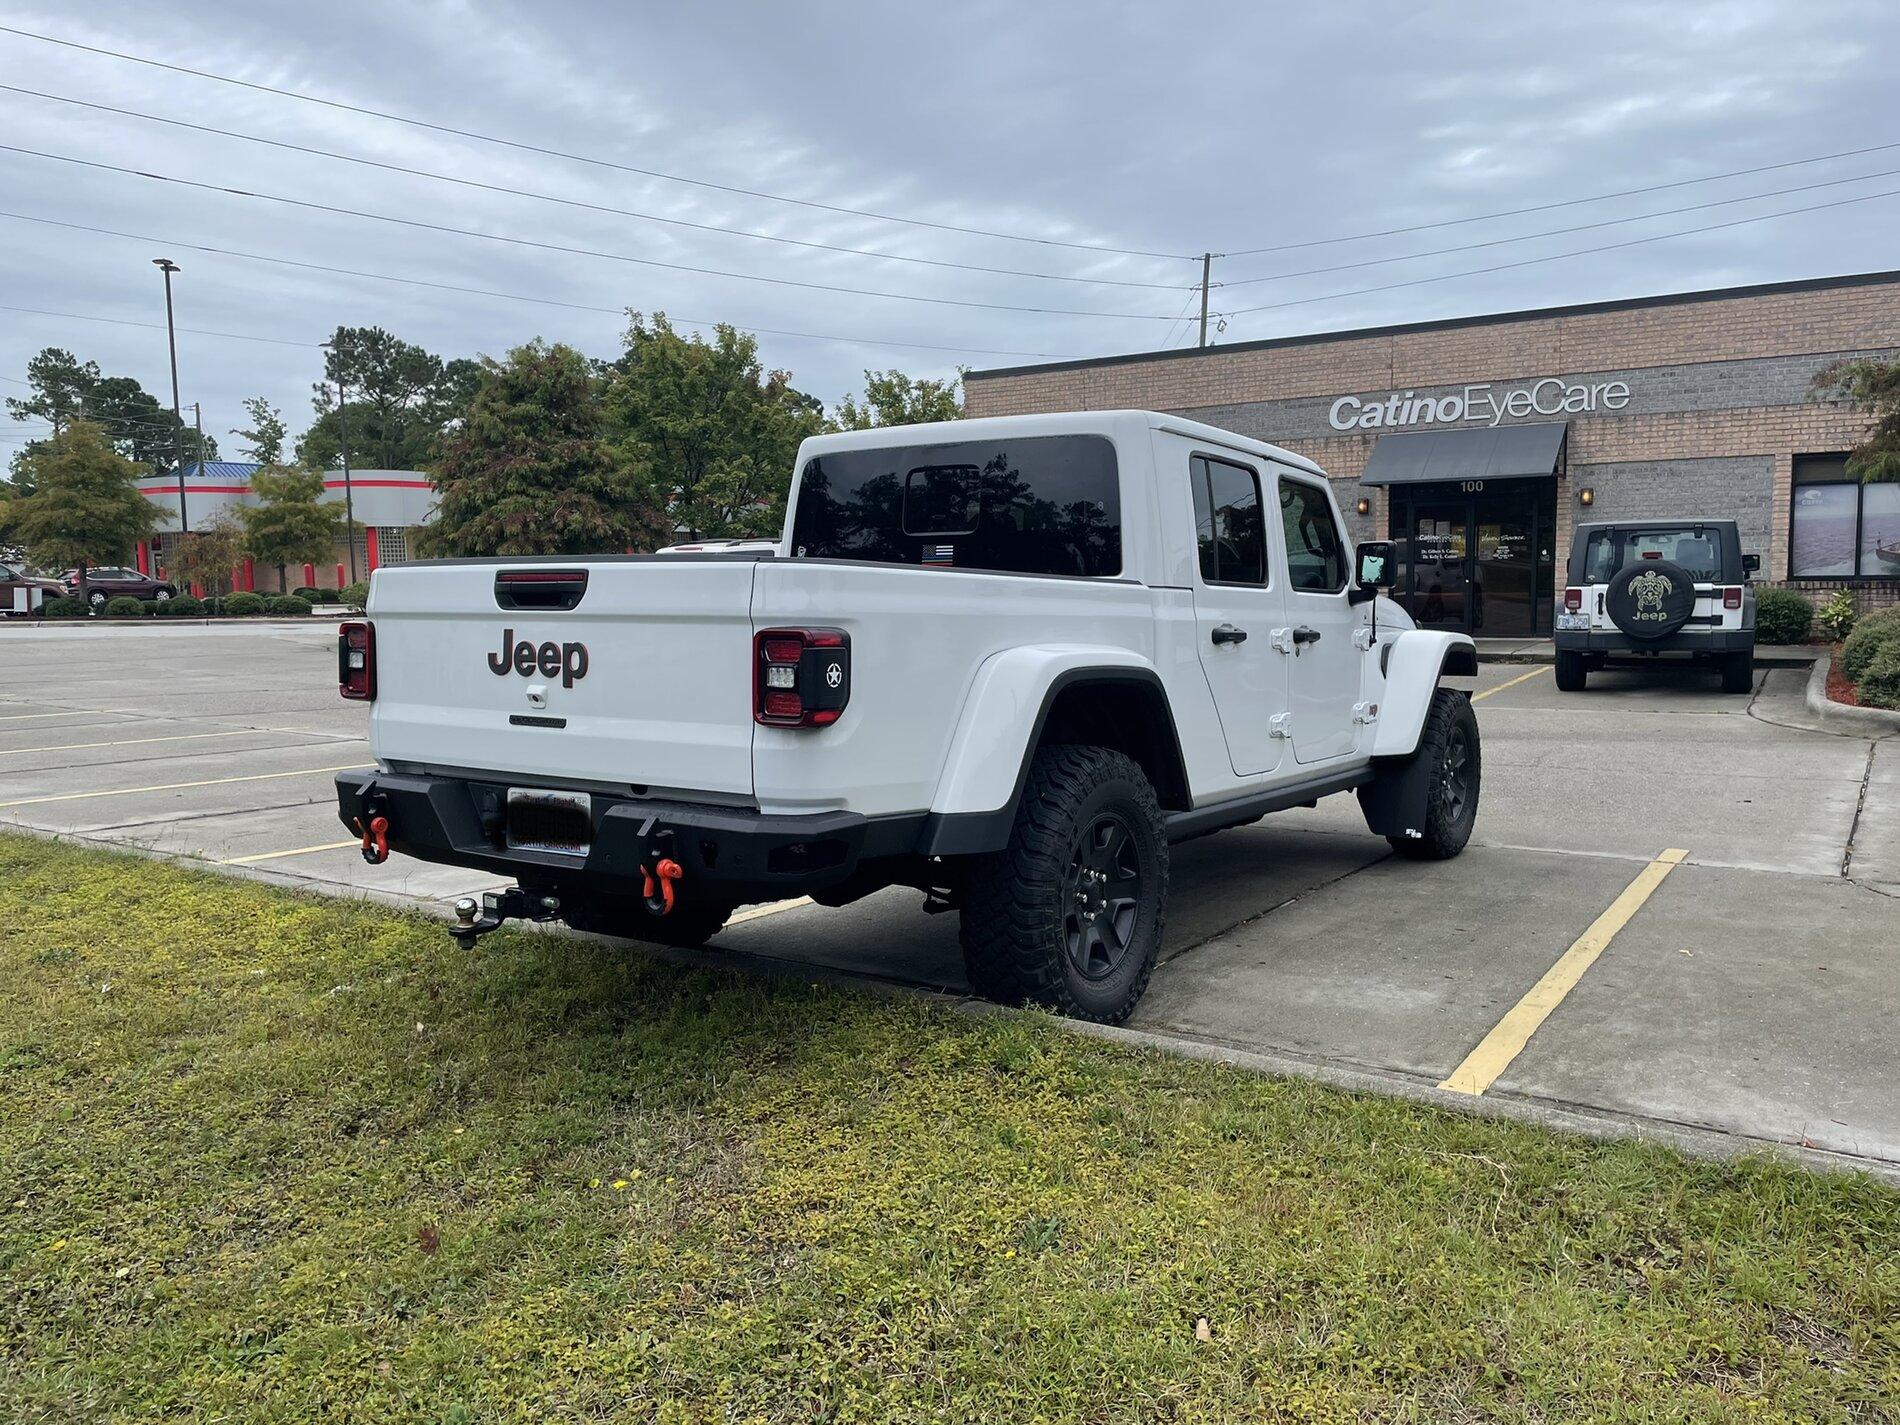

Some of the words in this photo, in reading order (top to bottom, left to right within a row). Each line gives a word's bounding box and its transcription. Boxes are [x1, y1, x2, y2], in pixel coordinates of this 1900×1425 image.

[1460, 480, 1484, 493] 100
[1632, 611, 1668, 621] Jeep
[487, 628, 589, 689] Jeep
